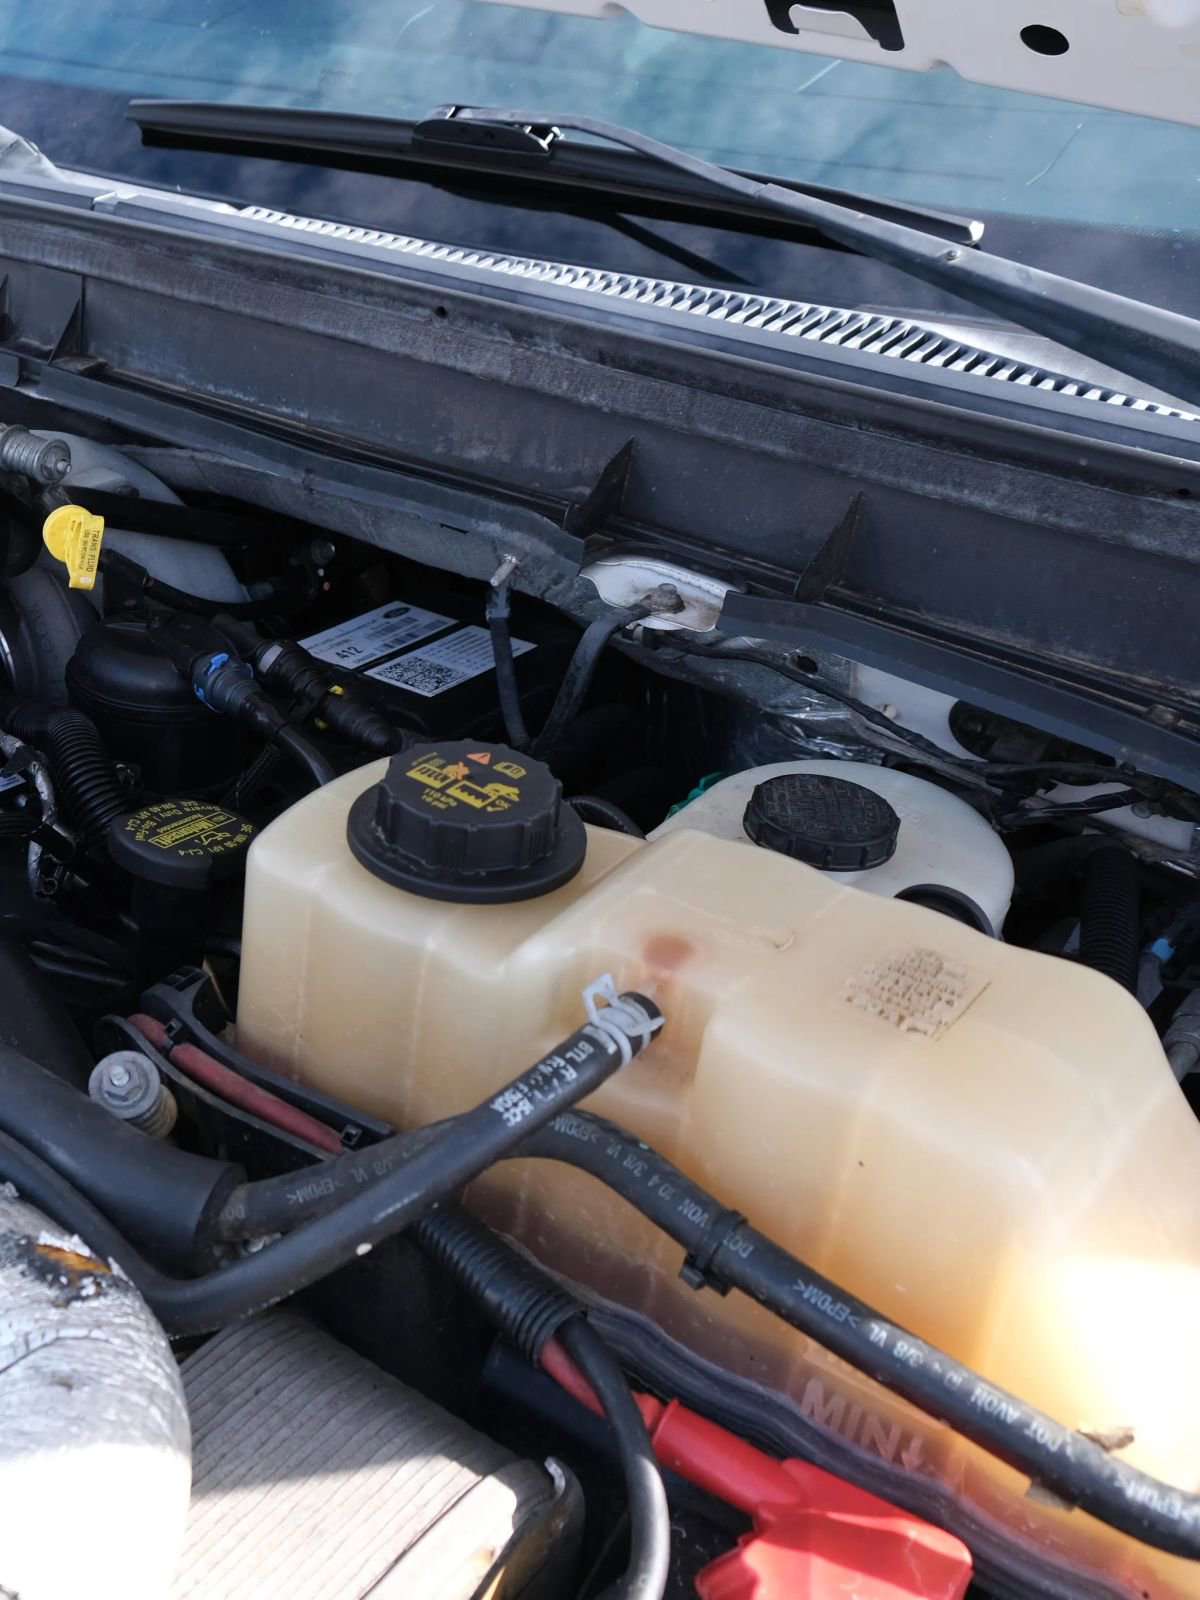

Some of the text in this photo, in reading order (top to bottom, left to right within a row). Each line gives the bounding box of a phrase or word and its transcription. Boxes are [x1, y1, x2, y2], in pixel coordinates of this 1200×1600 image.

[86, 530, 99, 573] TRANS FLUID
[334, 645, 364, 661] 412
[157, 820, 213, 845] Motorcraft
[622, 1154, 647, 1179] 3/8
[866, 1323, 890, 1347] VL
[800, 1377, 904, 1462] MIN
[971, 1388, 1021, 1426] AVON
